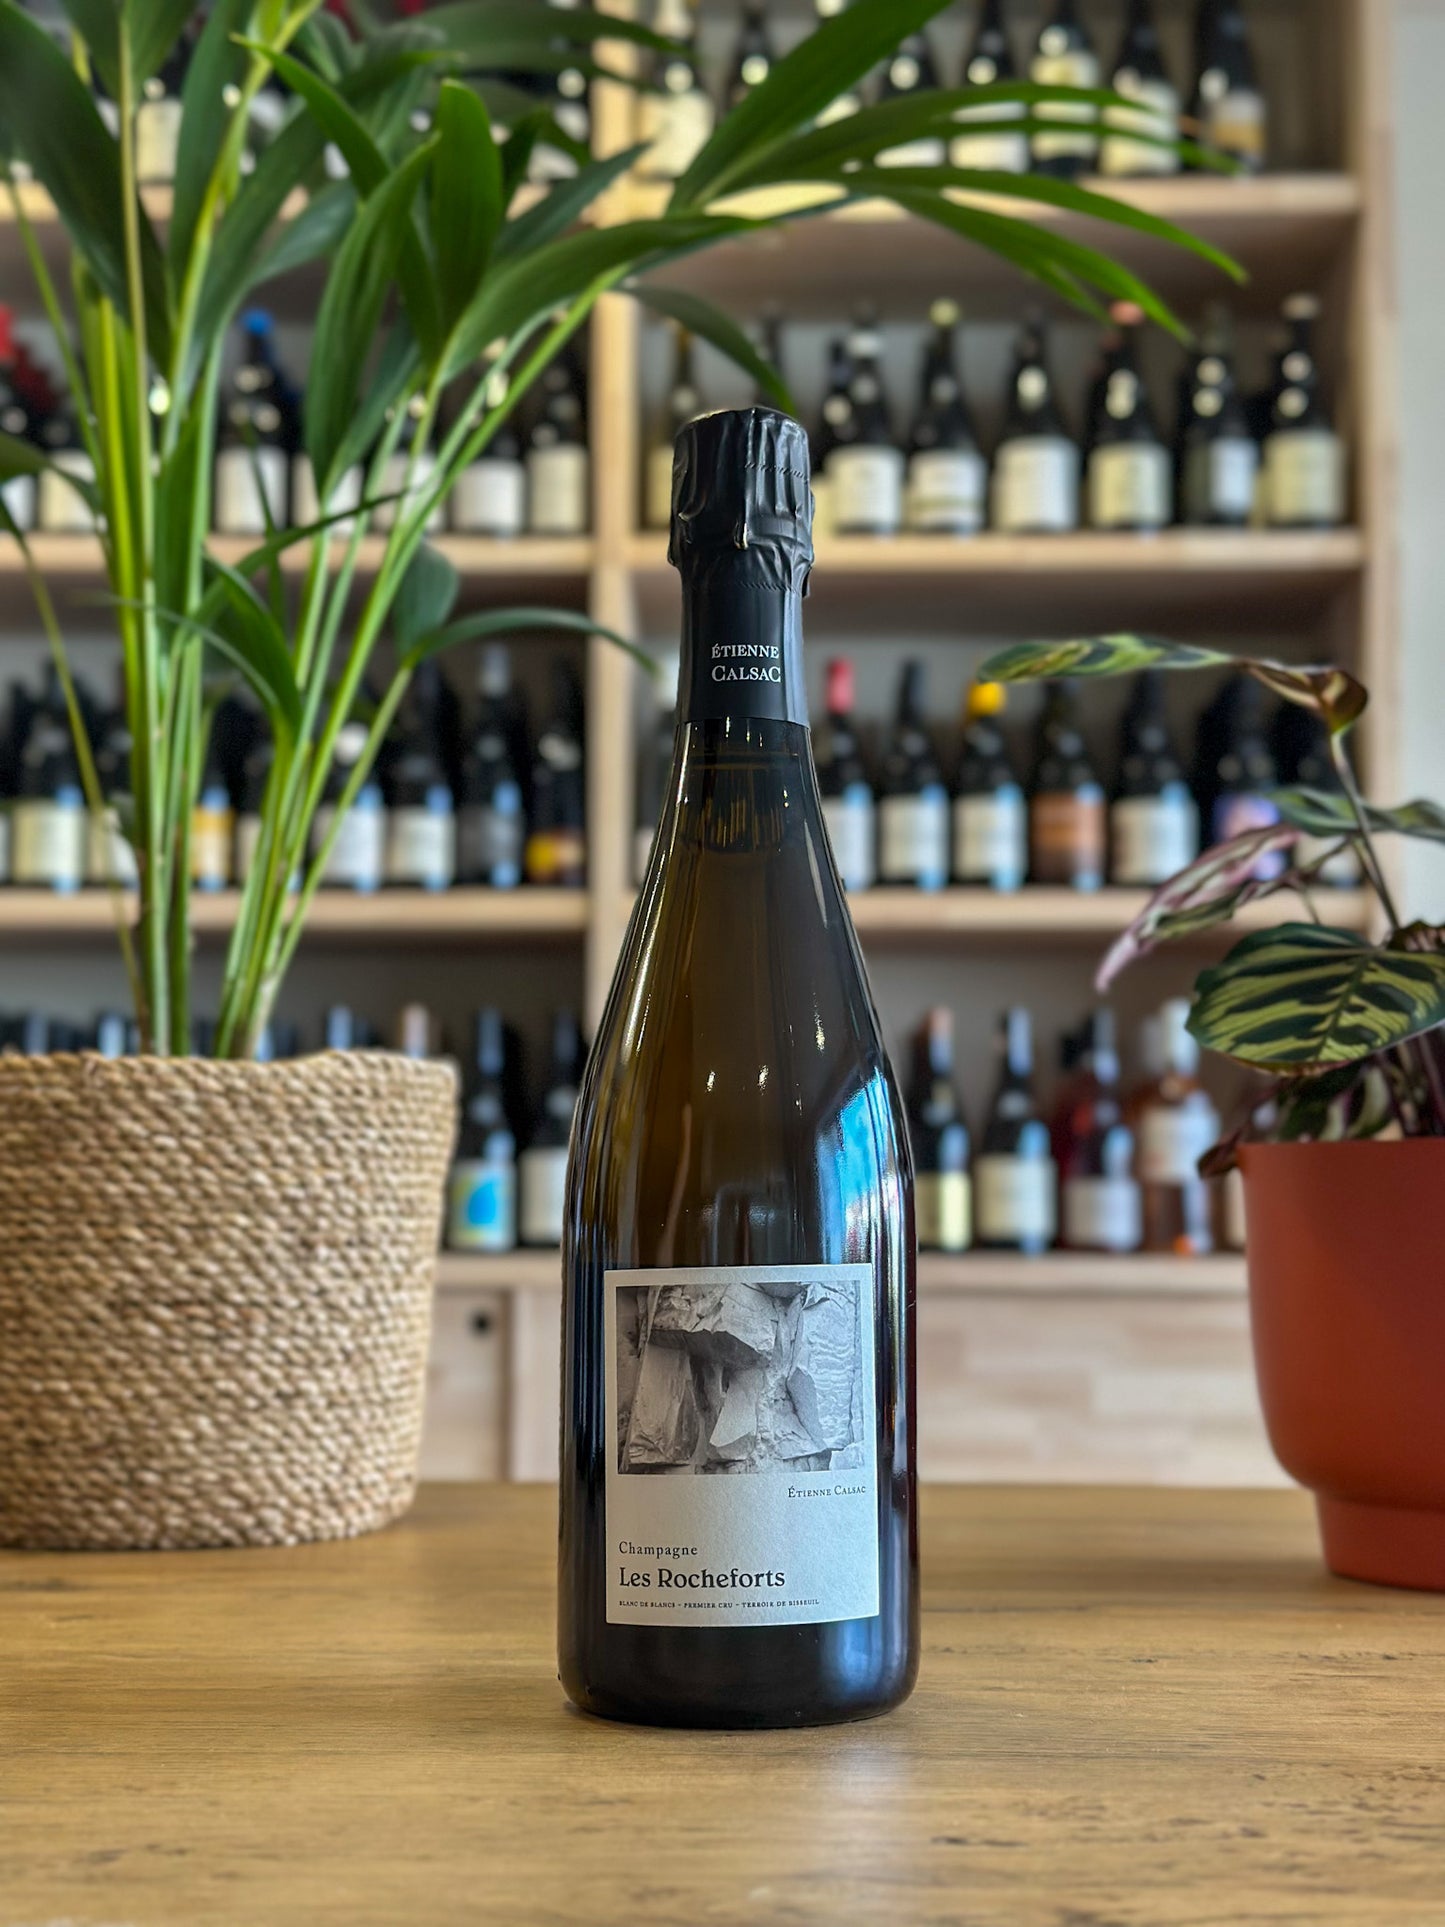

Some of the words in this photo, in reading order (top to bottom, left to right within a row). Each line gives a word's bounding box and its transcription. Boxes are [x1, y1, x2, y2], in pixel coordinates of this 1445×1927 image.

[711, 643, 780, 659] ÉTIENNE
[711, 665, 781, 682] CALSAC
[788, 1485, 832, 1498] ÉTIENNE
[834, 1485, 866, 1496] CALSAC
[619, 1541, 698, 1559] Champagne
[619, 1567, 651, 1587] Les
[658, 1568, 785, 1588] Rocheforts
